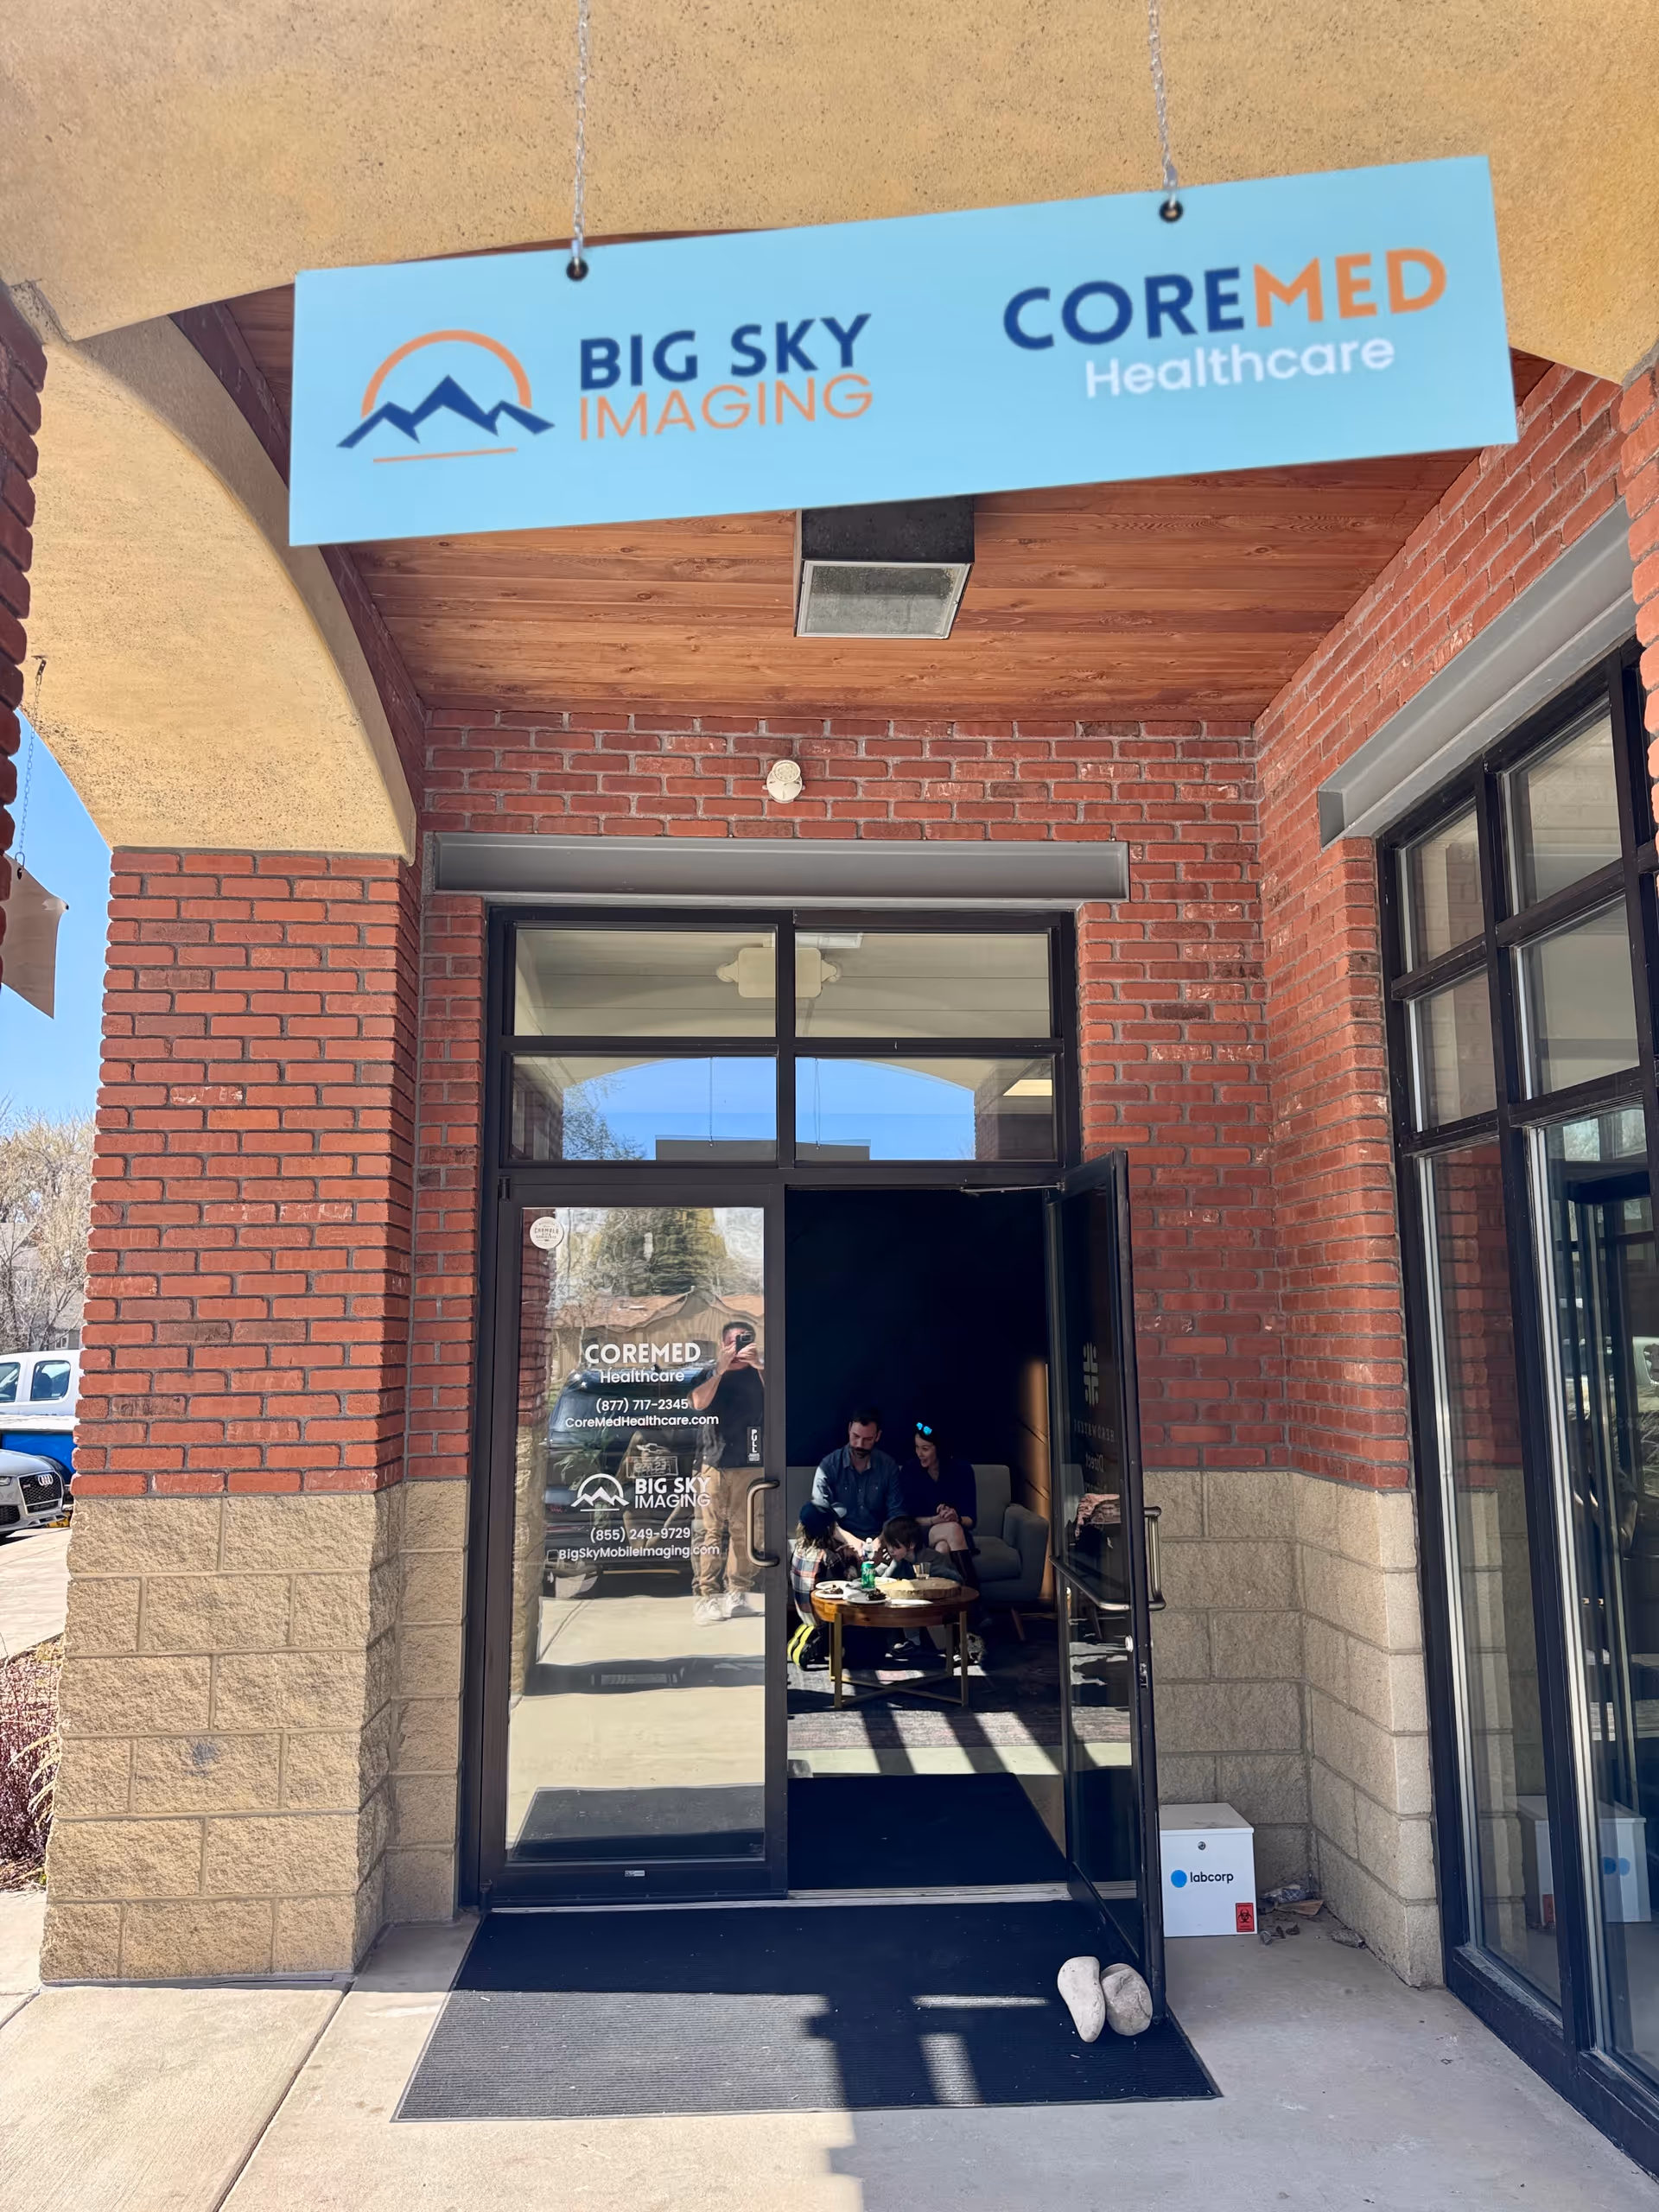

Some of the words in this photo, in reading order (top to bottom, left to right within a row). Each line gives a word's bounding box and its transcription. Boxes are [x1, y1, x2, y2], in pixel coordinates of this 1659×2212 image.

[1003, 248, 1446, 351] COREMED
[579, 329, 698, 391] BIG
[730, 313, 872, 378] SKY
[1085, 338, 1395, 398] Healthcare
[579, 372, 874, 441] IMAGING
[584, 1342, 702, 1363] COREMED
[600, 1369, 684, 1382] Healthcare
[595, 1397, 629, 1413] (877)
[632, 1398, 689, 1411] 717-2345
[565, 1414, 719, 1428] CoreMedHealthcare.com
[634, 1478, 667, 1495] BIG
[674, 1477, 711, 1494] SKY
[634, 1493, 711, 1509] IMAGING
[590, 1527, 626, 1543] (855)
[629, 1528, 690, 1540] 249-9729
[559, 1545, 720, 1560] BigSkyMobileImaging.com
[1190, 1871, 1234, 1884] labcorp
